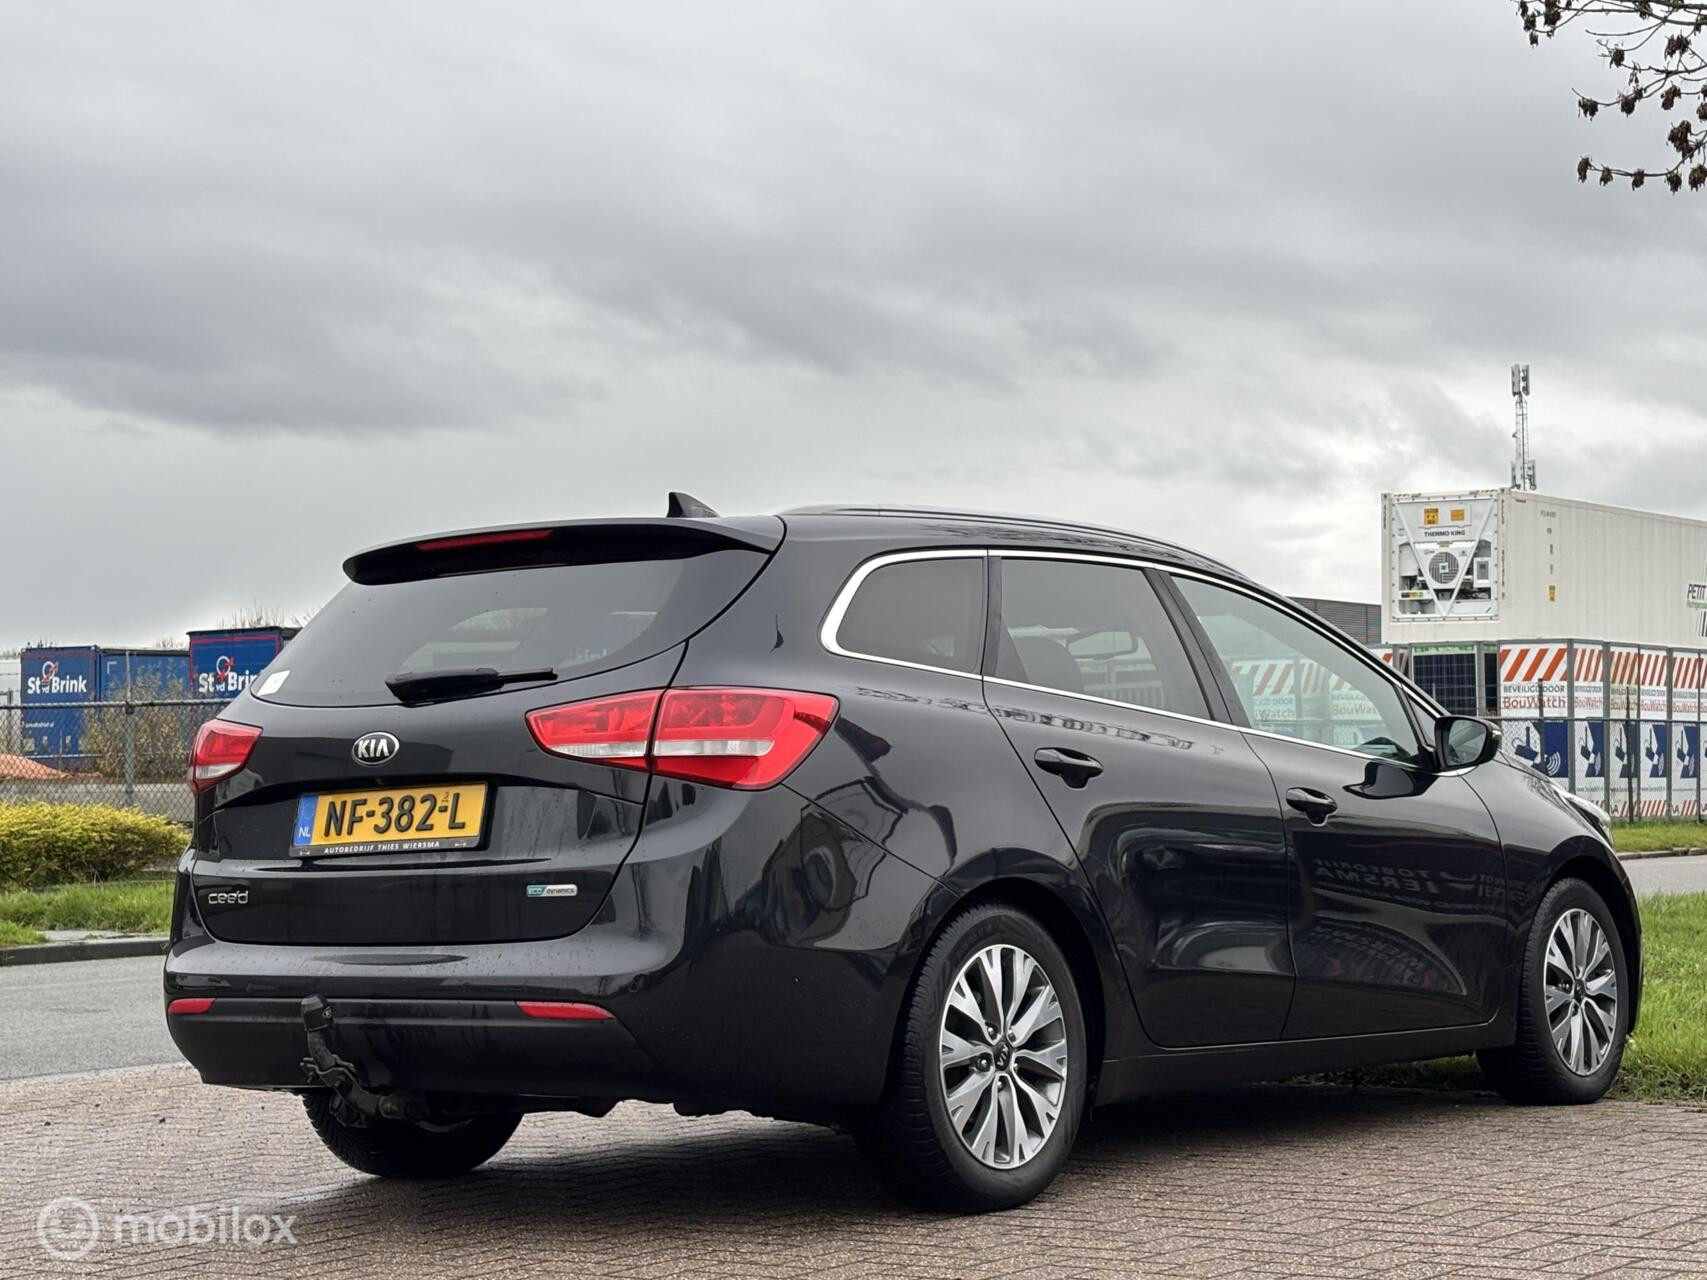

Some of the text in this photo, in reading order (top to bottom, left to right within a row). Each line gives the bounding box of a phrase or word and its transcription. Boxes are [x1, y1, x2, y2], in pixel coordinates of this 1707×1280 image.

[27, 676, 41, 694] St
[51, 675, 87, 693] Brink
[198, 672, 215, 692] St
[358, 738, 390, 758] KIA
[323, 792, 467, 838] NF-382-L
[298, 826, 311, 838] NL
[323, 841, 440, 855] AUTOBEDRIJF THIES WIERSMA
[208, 890, 249, 905] cee'd
